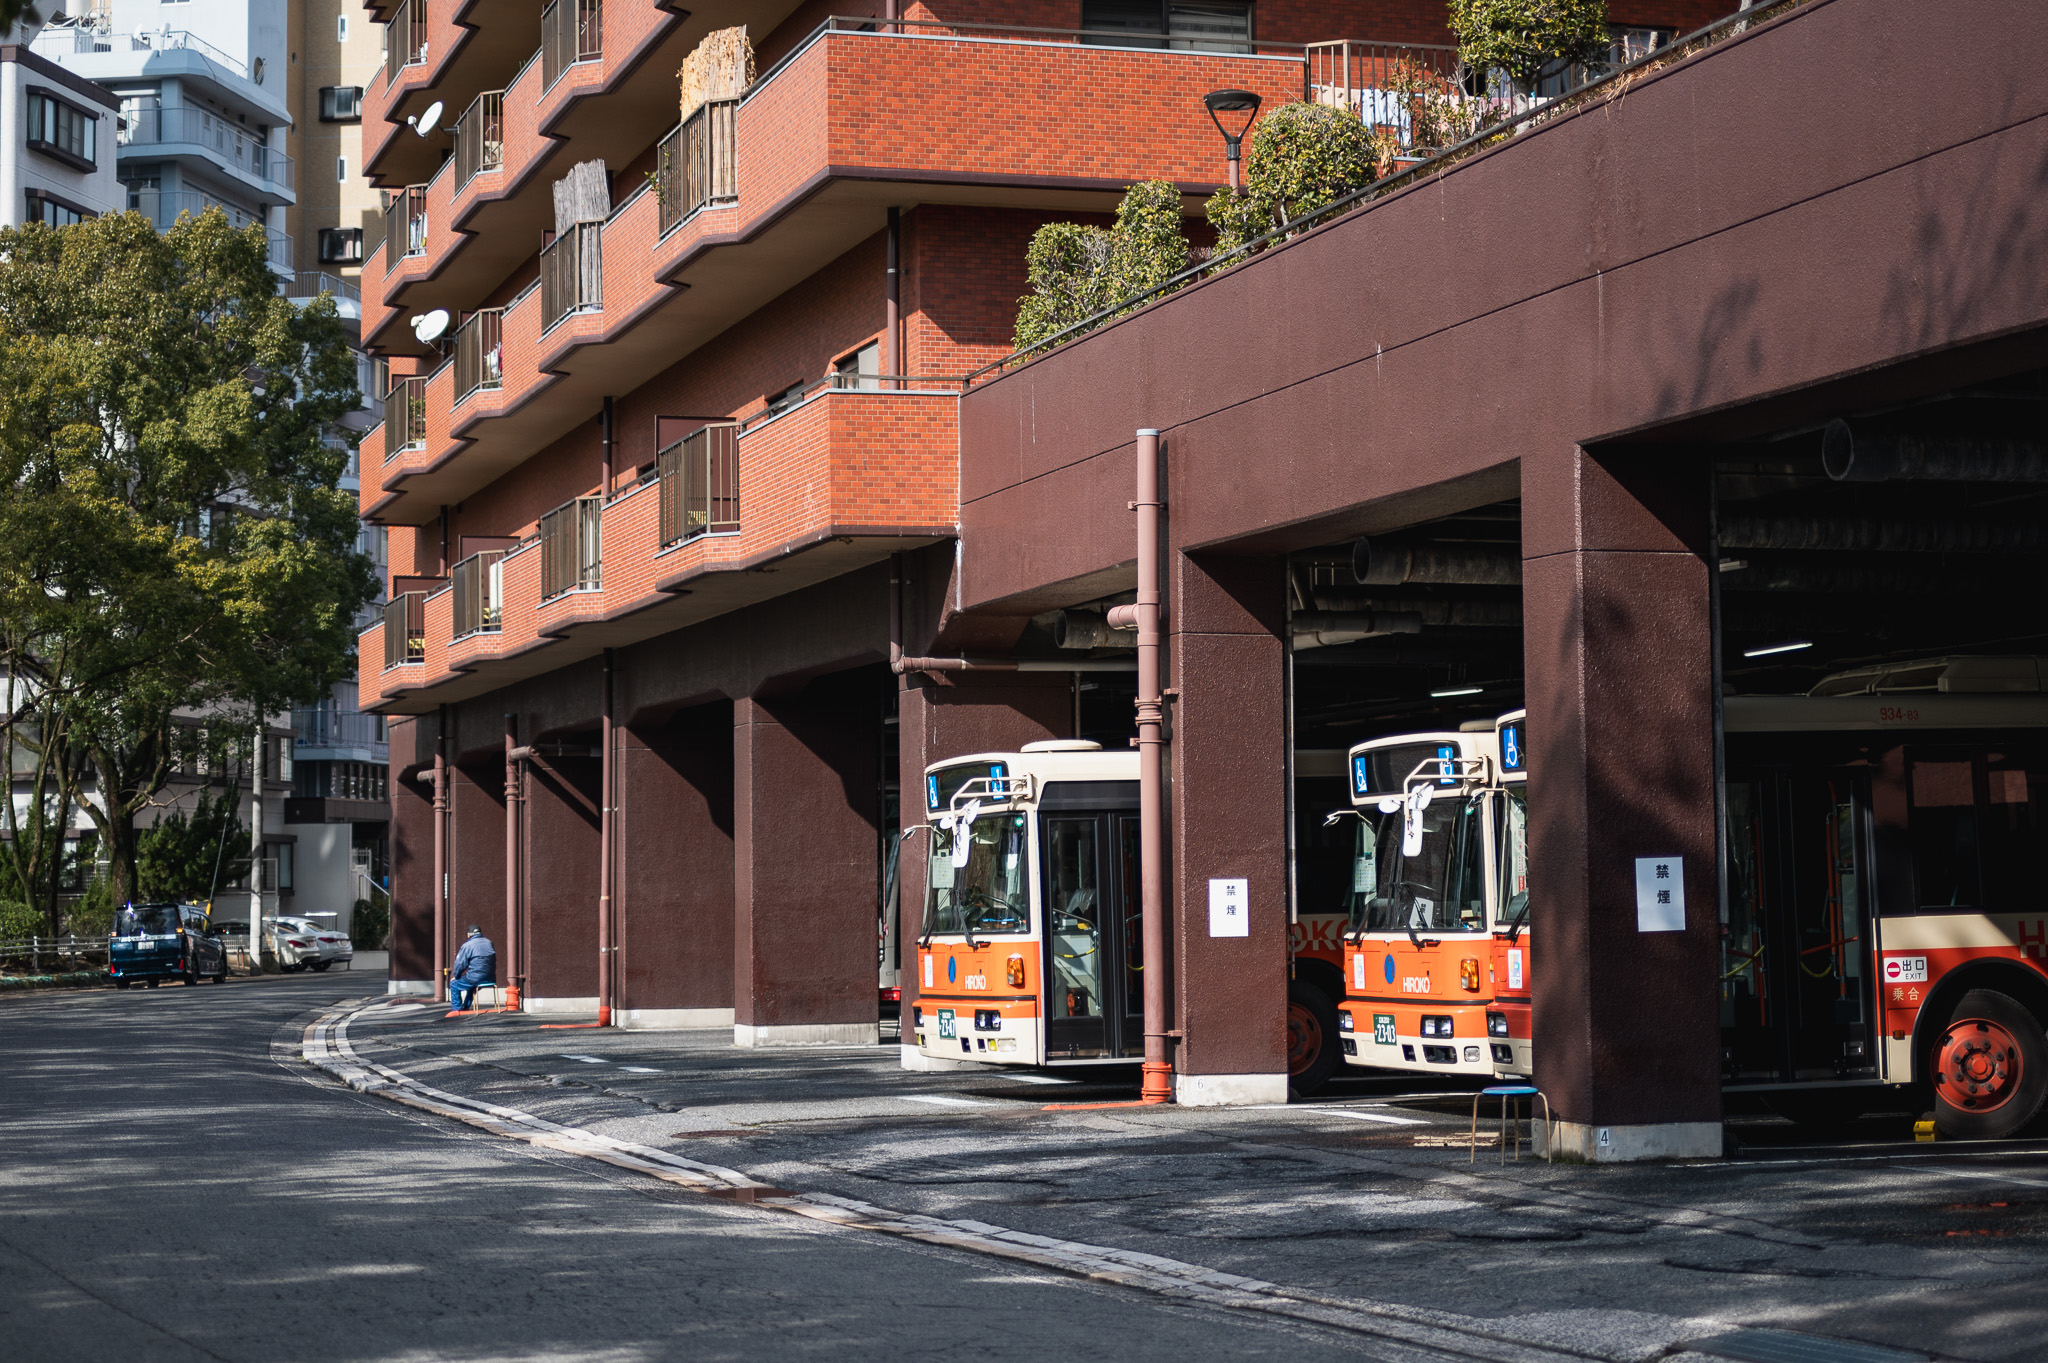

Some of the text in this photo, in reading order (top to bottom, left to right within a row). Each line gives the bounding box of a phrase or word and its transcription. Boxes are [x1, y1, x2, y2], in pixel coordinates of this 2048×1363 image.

[1880, 707, 1919, 720] 934-83
[1656, 864, 1671, 904] 禁煙
[1226, 885, 1237, 916] 禁煙
[1902, 959, 1925, 972] 出口
[965, 975, 986, 990] HIROKO
[1905, 972, 1922, 980] EXIT
[1403, 977, 1430, 993] HIROKO
[1892, 986, 1920, 1001] 乗合
[941, 1019, 955, 1037] 23-47
[1377, 1024, 1396, 1043] 23-03
[1197, 1078, 1204, 1090] 6
[1600, 1130, 1609, 1145] 4
